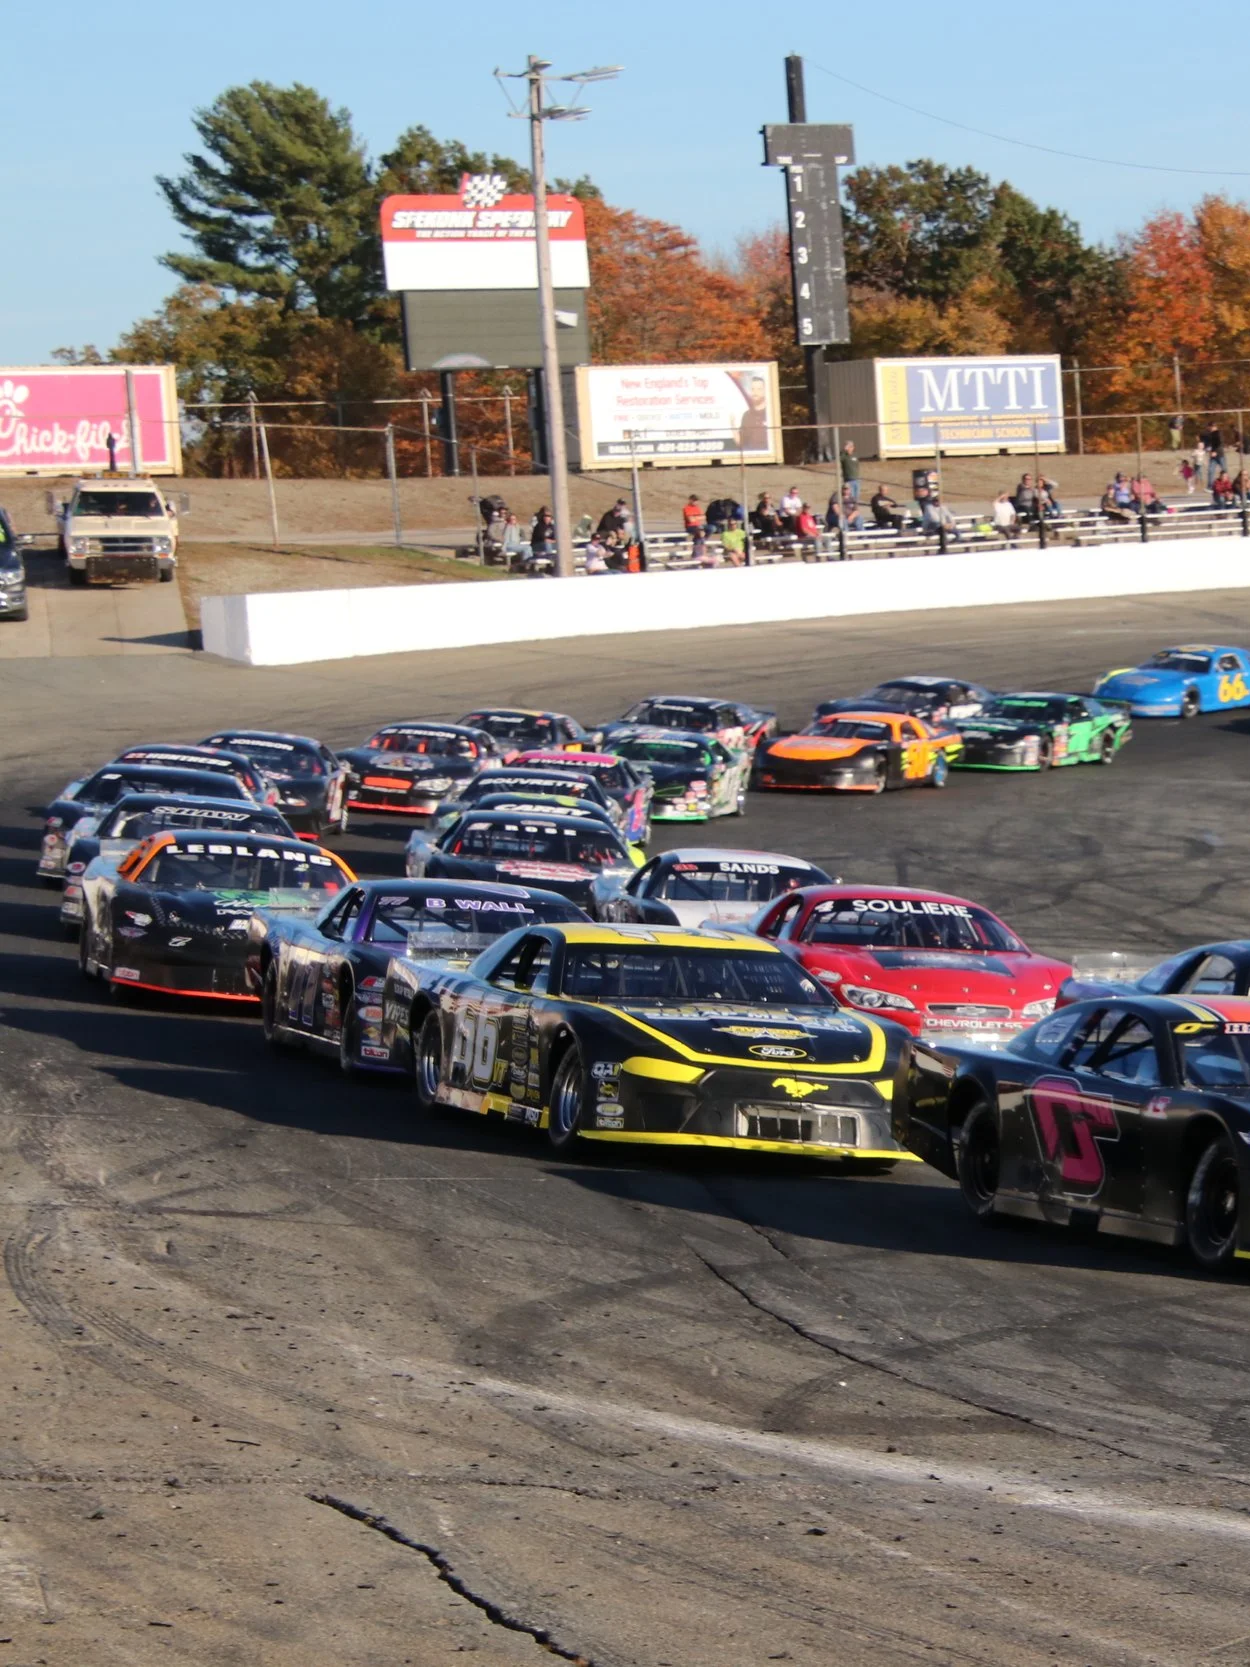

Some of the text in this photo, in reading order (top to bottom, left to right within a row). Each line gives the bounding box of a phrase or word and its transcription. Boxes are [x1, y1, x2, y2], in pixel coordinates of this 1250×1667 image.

[794, 175, 803, 192] 1
[795, 211, 806, 228] 2
[797, 247, 808, 264] 3
[800, 282, 810, 299] 4
[802, 318, 813, 335] 5
[917, 366, 1048, 412] MTTI
[152, 806, 250, 821] SHAW
[166, 844, 333, 867] LEBLANC
[719, 862, 780, 875] SANDS
[426, 897, 447, 909] B
[455, 898, 535, 914] WALL
[815, 899, 973, 919] 4 SOULIERE
[926, 1017, 998, 1029] CHEVROLET
[760, 1045, 797, 1058] Ford
